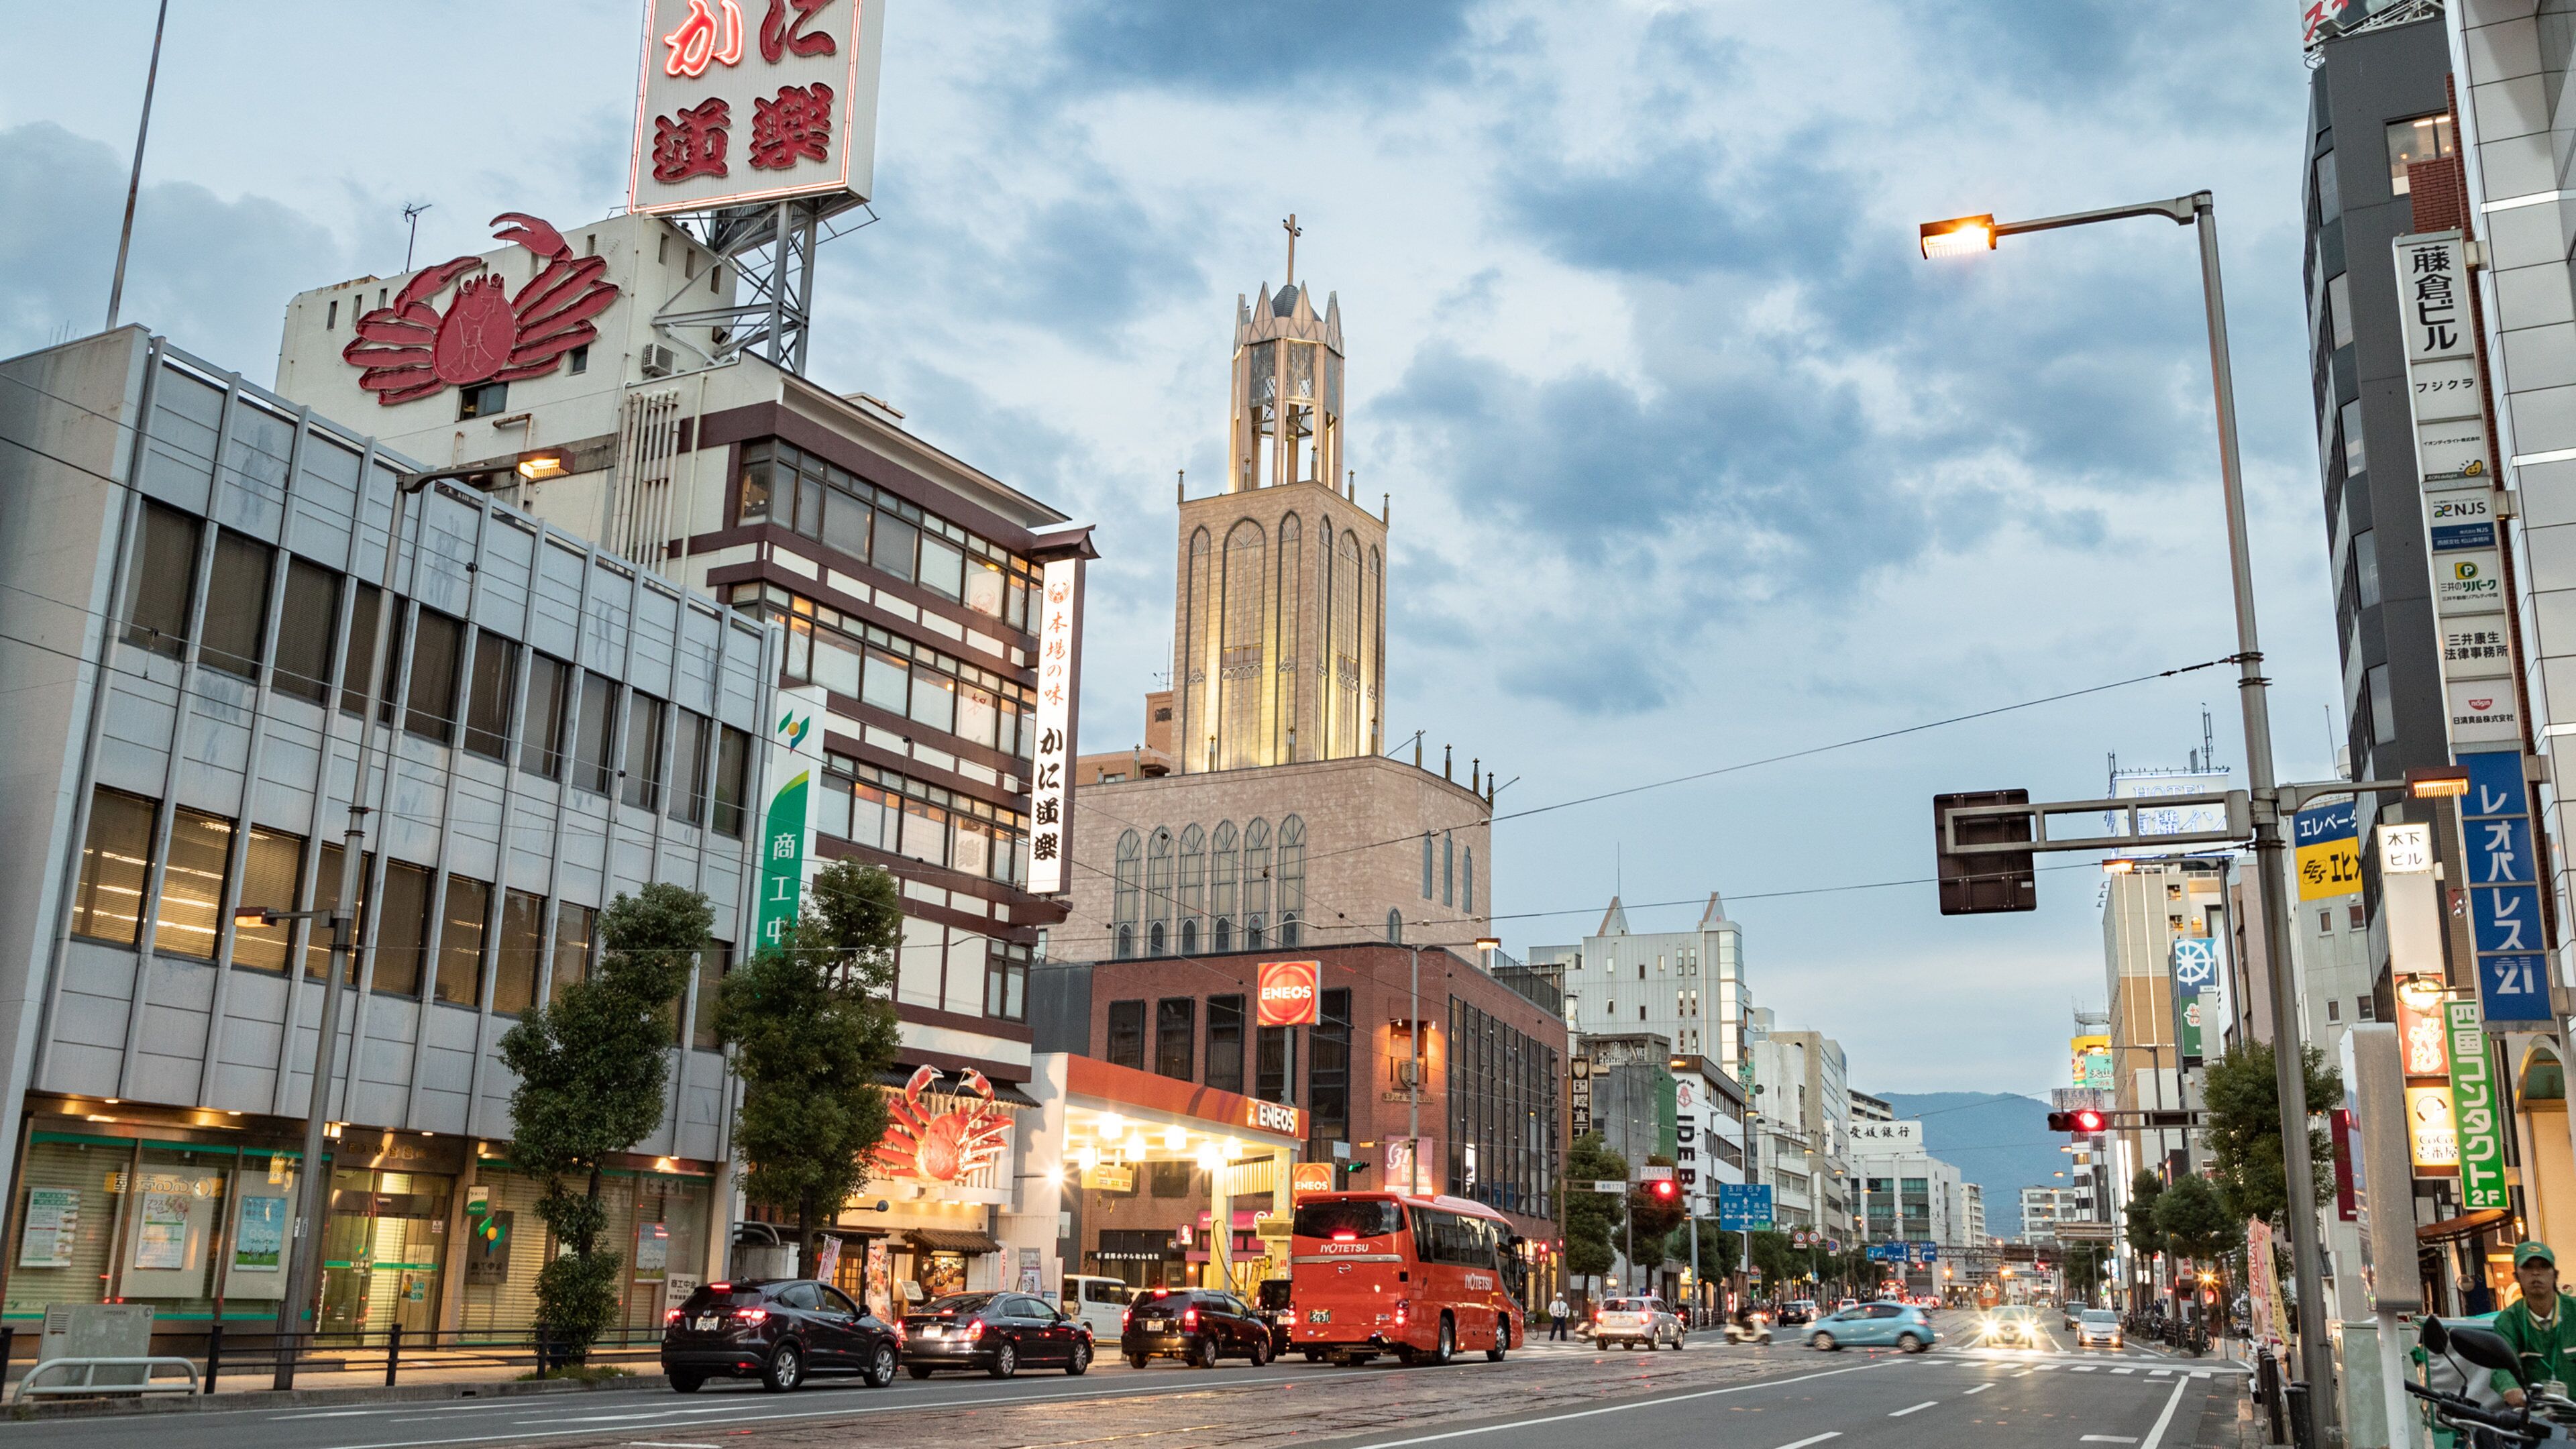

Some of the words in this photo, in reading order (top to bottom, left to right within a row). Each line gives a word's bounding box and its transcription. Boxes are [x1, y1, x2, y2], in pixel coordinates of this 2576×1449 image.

[662, 0, 837, 78] かに
[2412, 245, 2458, 352] 藤倉ビル
[2416, 378, 2474, 393] フジクラ
[2423, 436, 2481, 446] イオンディライト株式会社
[2455, 502, 2486, 516] NJS
[2461, 535, 2489, 543] 松山事務所
[2440, 579, 2497, 592] 三井のリパーク
[2442, 592, 2498, 602] 三井不動産リアルティ中国
[2449, 631, 2500, 647] 三井康生
[1044, 610, 1068, 706] 本場の味
[2445, 645, 2508, 661] 法律事務所
[2453, 714, 2514, 724] 日清食品株式会社
[2387, 832, 2421, 847] 木下
[2390, 851, 2423, 866] ビル
[2480, 784, 2536, 995] レオパレス21
[1261, 985, 1312, 1000] ENEOS
[2090, 1069, 2114, 1079] 天山
[1259, 1104, 1295, 1133] ENEOS
[1849, 1126, 1911, 1139] 愛媛銀行
[2419, 1135, 2453, 1144] CoCo
[1295, 1179, 1328, 1191] ENEOS
[2471, 1189, 2501, 1205] 2F
[1320, 1243, 1369, 1253] IYOTETSU
[671, 1279, 698, 1289] 商工中金
[1465, 1273, 1493, 1291] IYOTETSU
